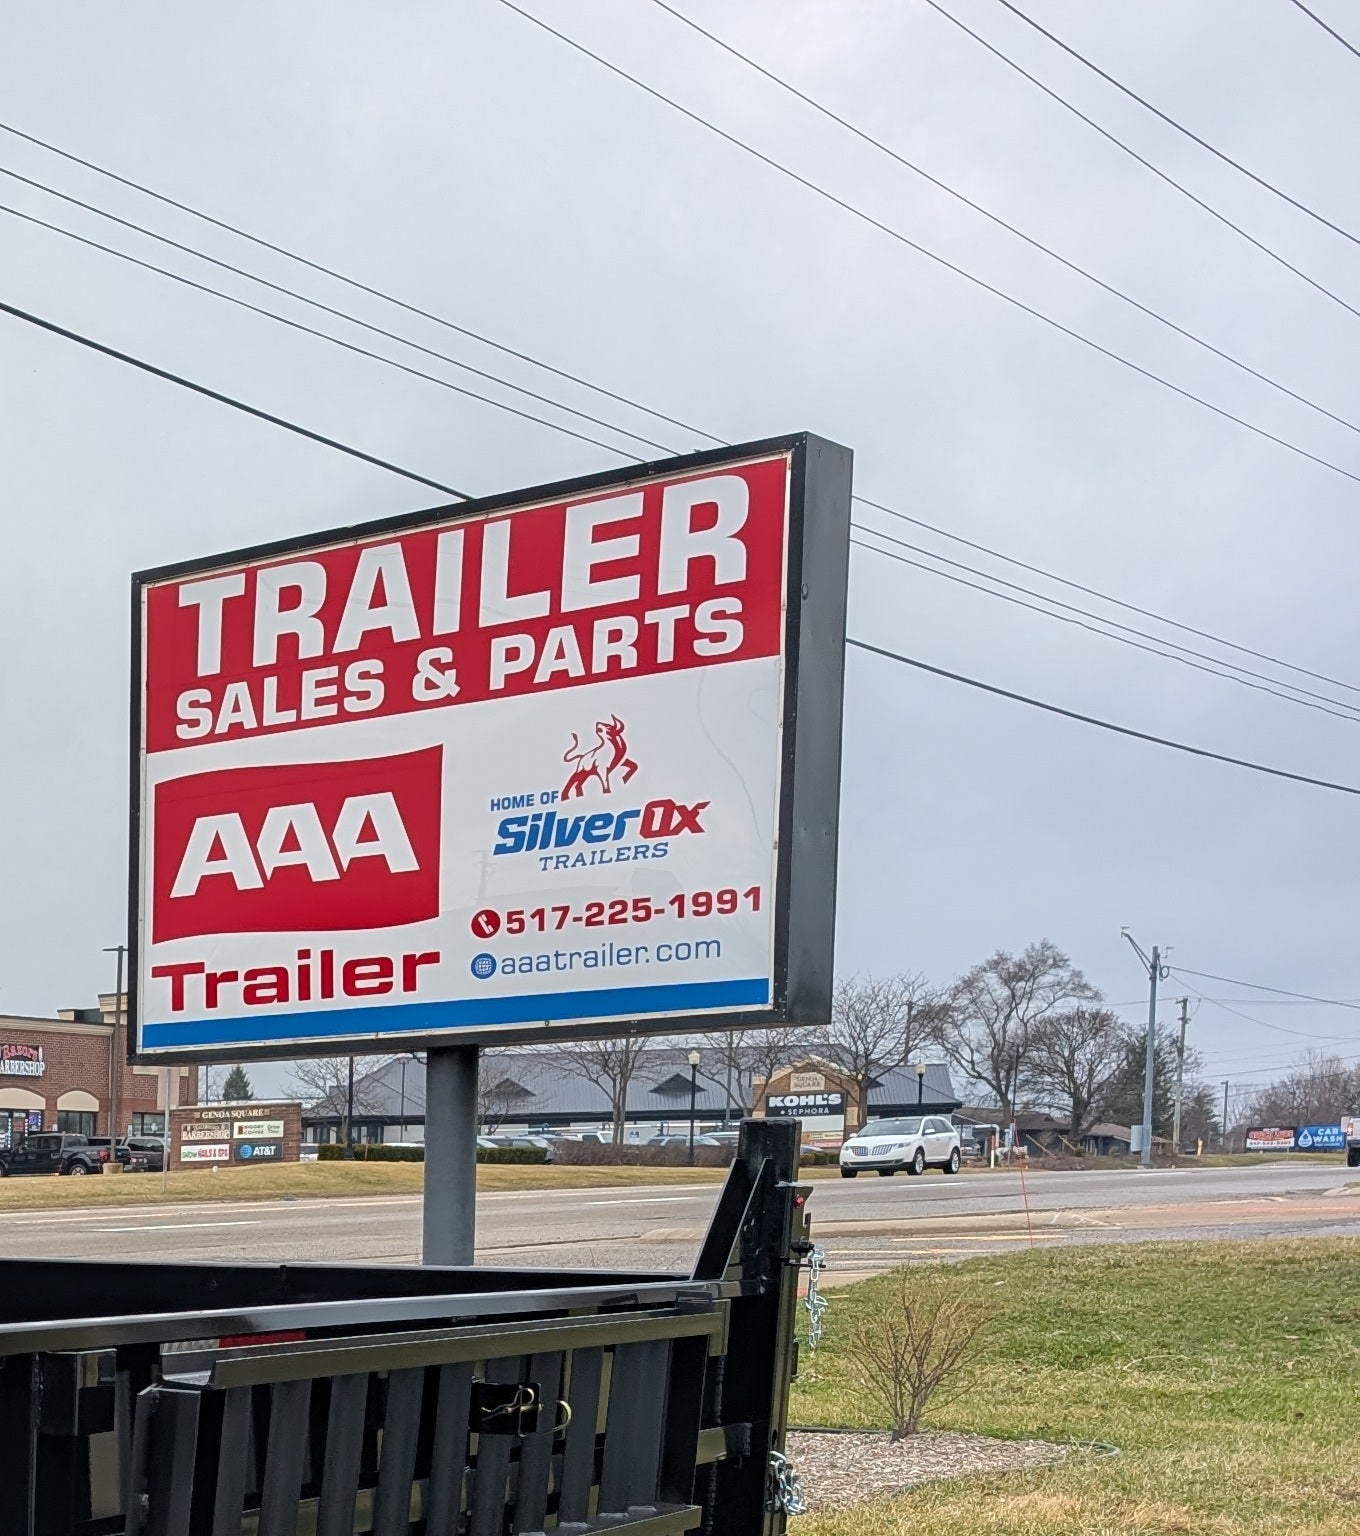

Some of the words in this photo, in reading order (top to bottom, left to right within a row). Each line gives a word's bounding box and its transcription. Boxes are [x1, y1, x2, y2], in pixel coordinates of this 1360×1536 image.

[180, 474, 750, 678] TRAILER
[175, 658, 385, 742] SALES
[411, 645, 461, 701] &
[489, 597, 744, 692] PARTS
[489, 795, 536, 811] HOME
[539, 790, 560, 806] OF
[170, 792, 420, 899] AAA
[538, 842, 670, 871] TRAILERS
[505, 886, 763, 934] 517-225-1991
[500, 937, 722, 976] aaatrailer.com
[150, 948, 441, 1013] Trailer
[201, 1110, 230, 1119] GENOA
[231, 1108, 264, 1118] SQUARE
[768, 1093, 842, 1107] KOHL'S
[788, 1107, 829, 1116] SEPHORA
[253, 1145, 276, 1156] AT&T
[1313, 1135, 1343, 1143] WASH
